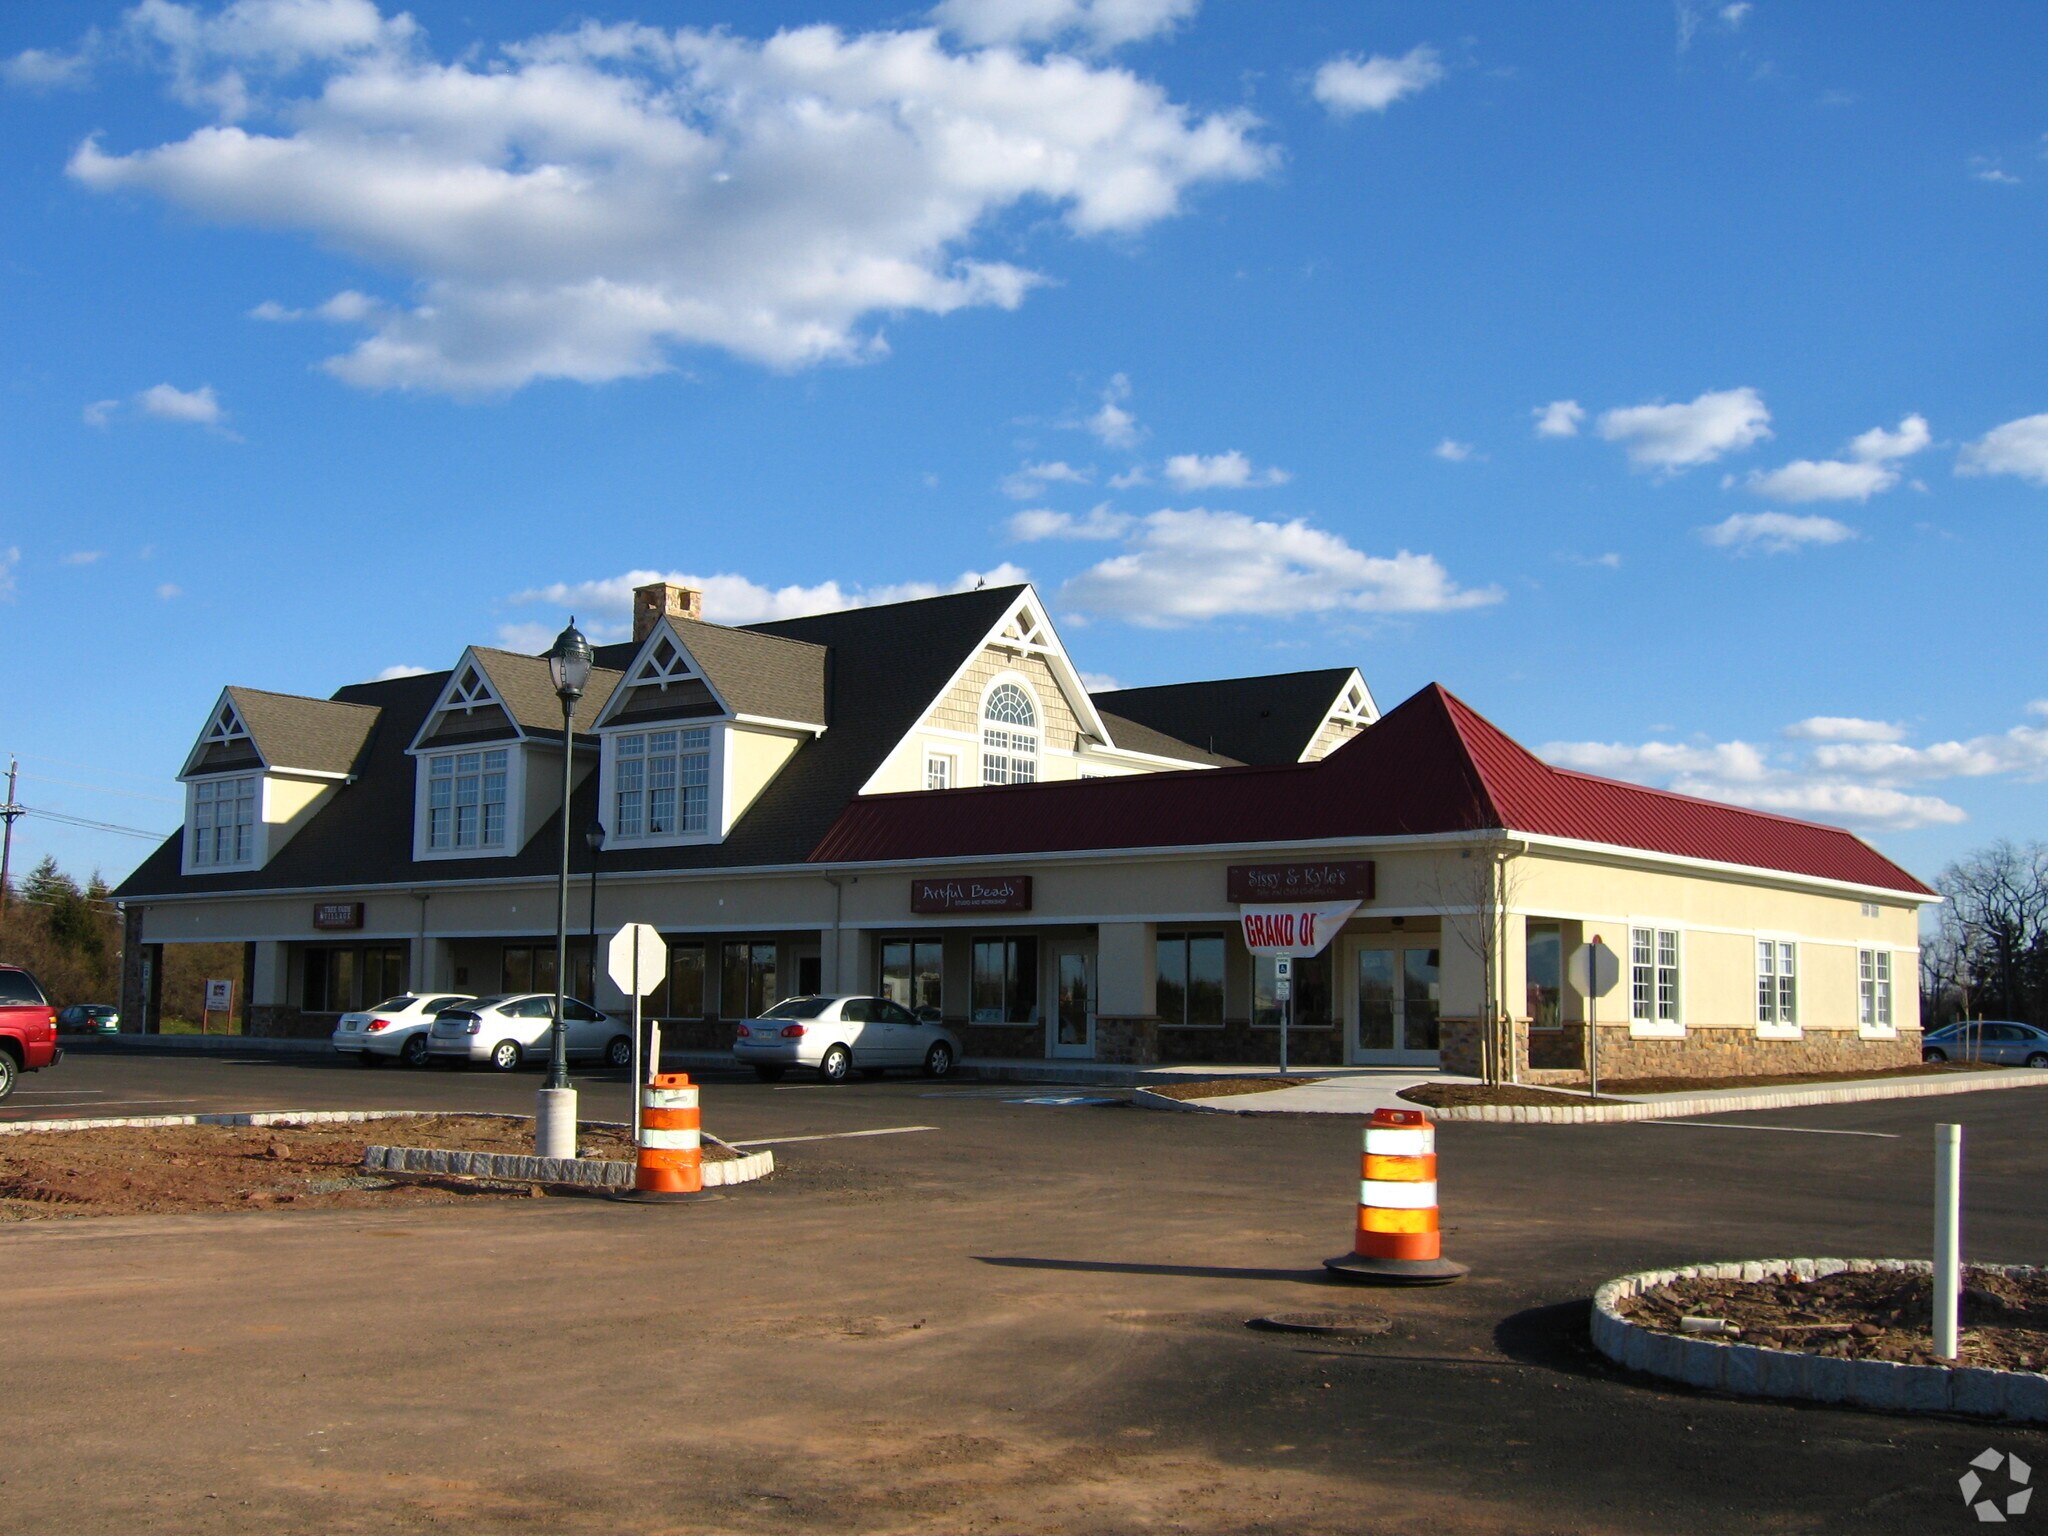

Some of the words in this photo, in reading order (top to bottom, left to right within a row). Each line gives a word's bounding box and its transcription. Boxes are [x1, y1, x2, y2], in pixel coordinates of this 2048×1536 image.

[1248, 870, 1280, 889] Sissy
[1286, 867, 1300, 886] &
[1304, 866, 1346, 886] Kyle's
[923, 883, 964, 908] Artful
[971, 882, 1015, 898] Beads
[1245, 914, 1294, 947] GRAND
